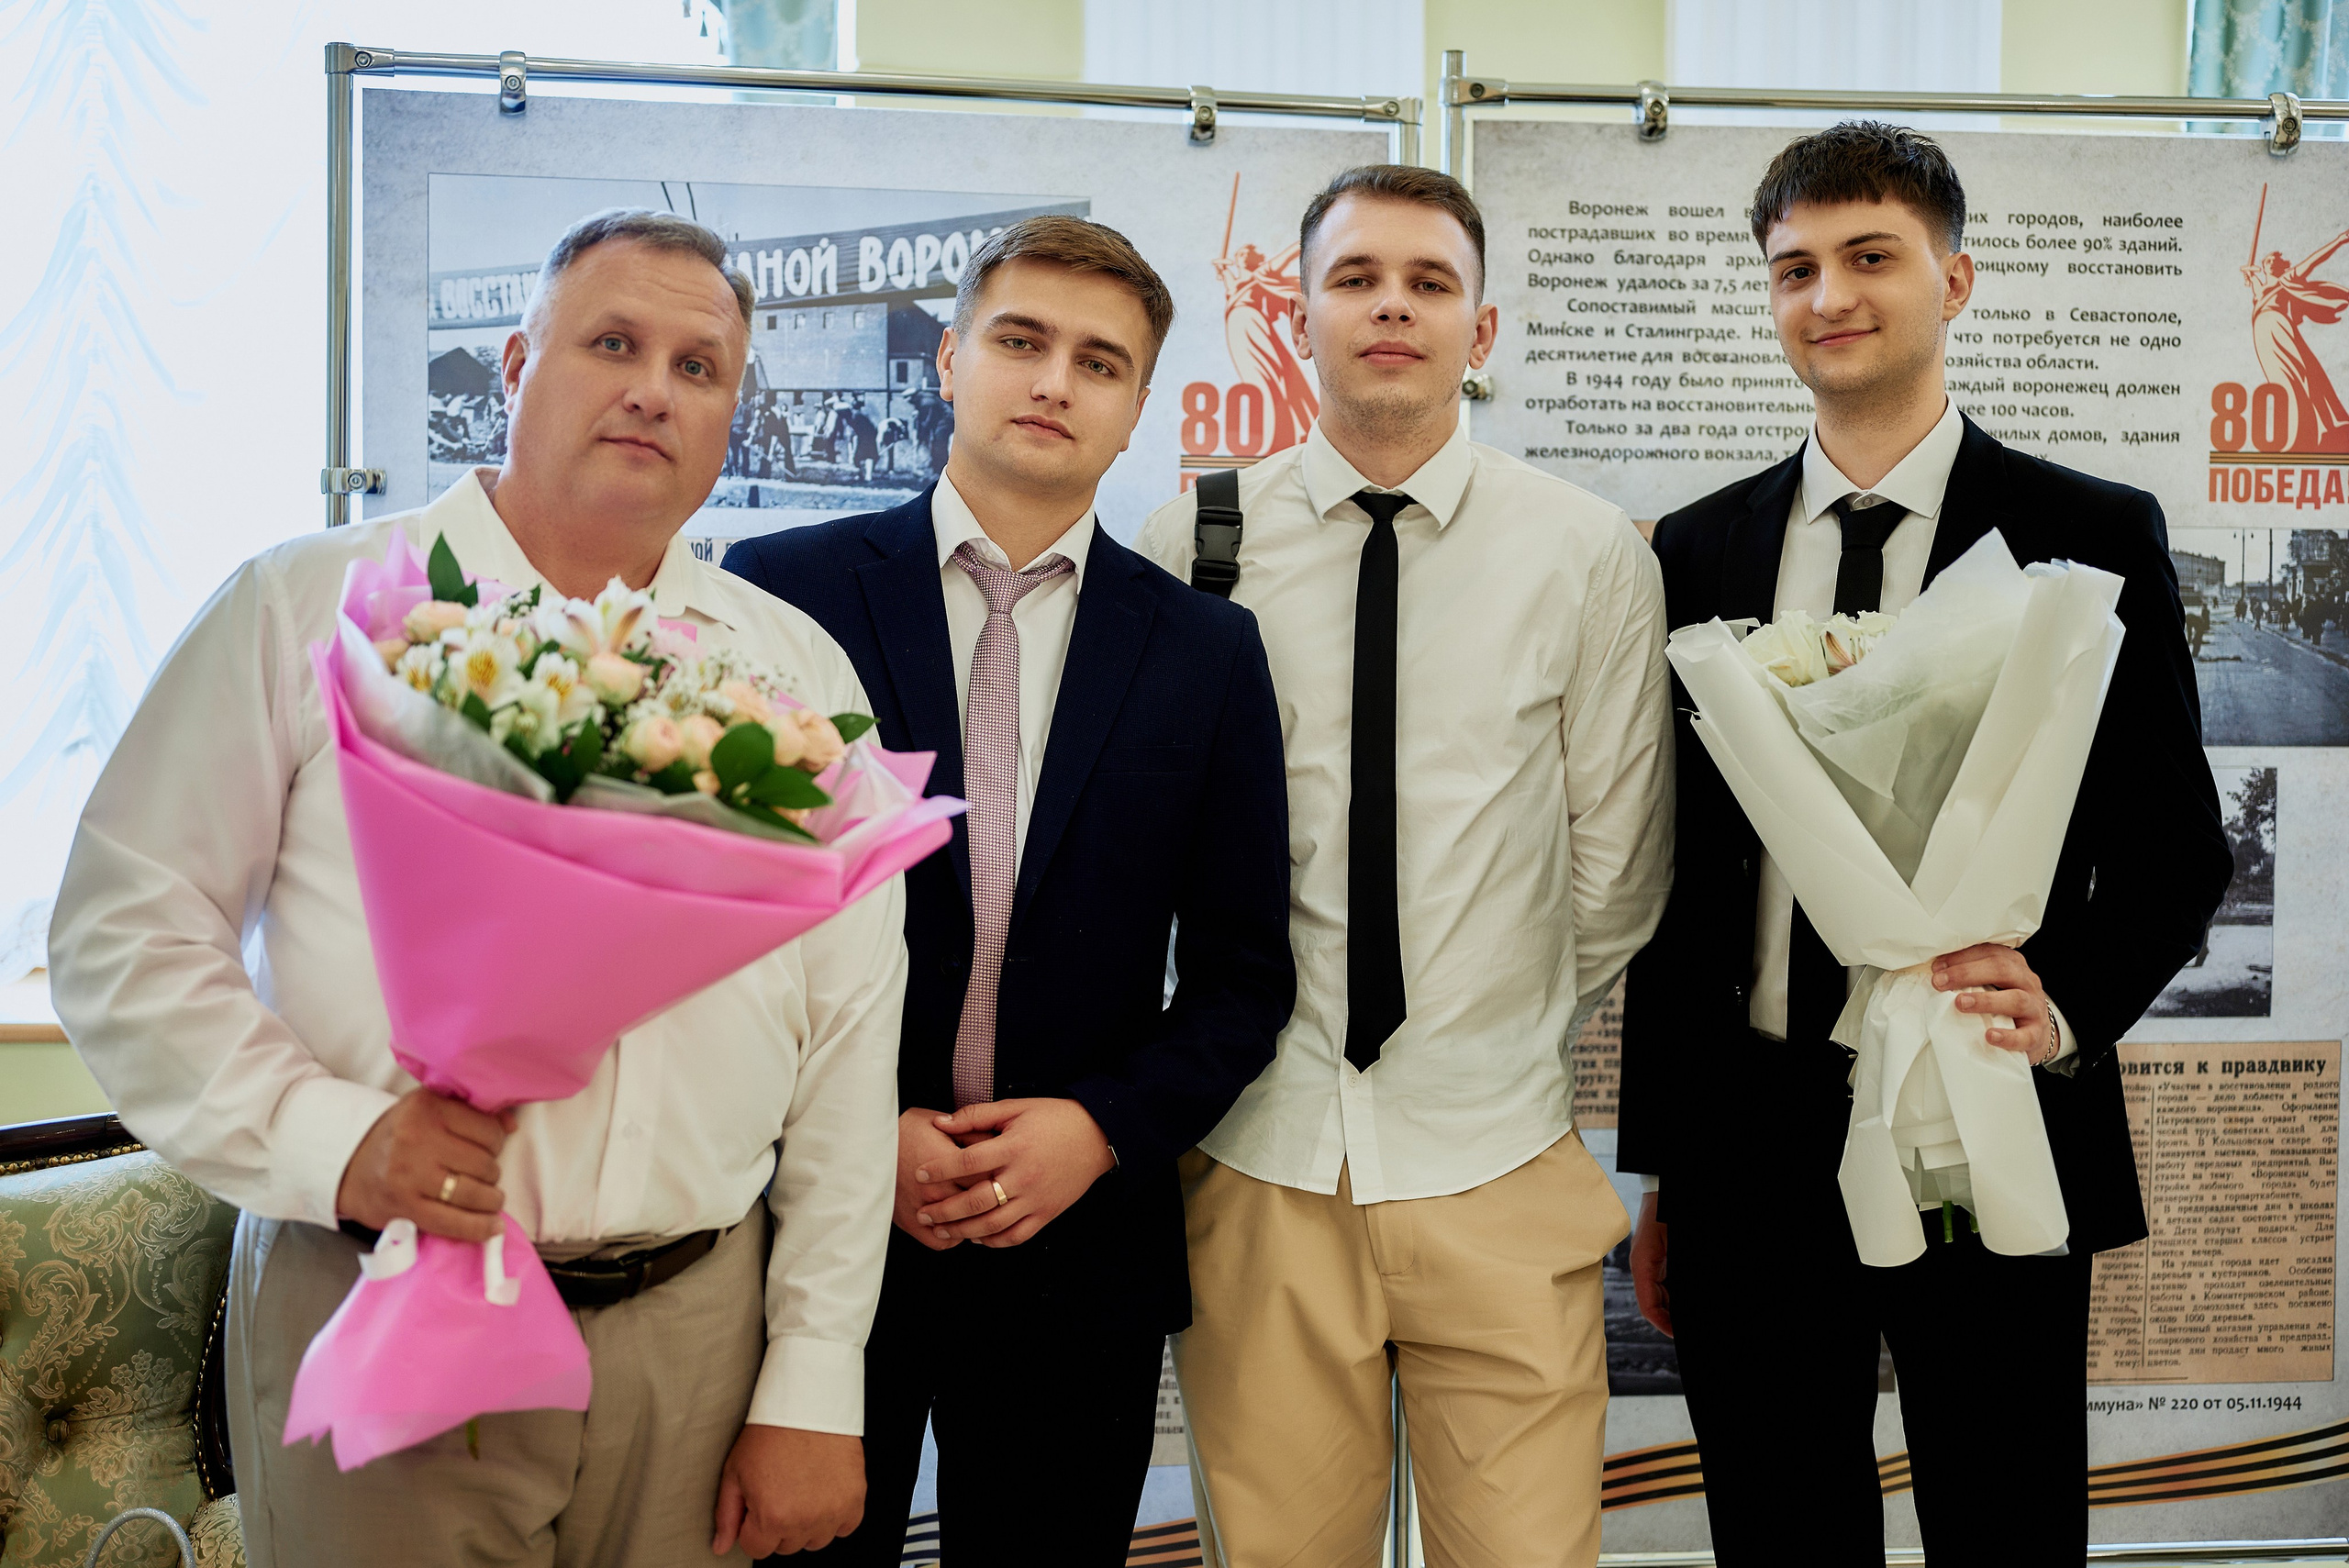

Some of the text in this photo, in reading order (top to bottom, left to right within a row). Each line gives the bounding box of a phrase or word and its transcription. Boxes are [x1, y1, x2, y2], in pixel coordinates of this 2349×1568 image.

[1568, 200, 1649, 219] Воронеж
[1668, 206, 1725, 218] вошел
[1965, 212, 1987, 226] их
[2008, 213, 2084, 229] городов,
[2102, 212, 2184, 228] наиболее
[1528, 228, 1655, 244] пострадавших
[1668, 229, 1689, 242] во
[1696, 230, 1750, 245] время
[2025, 234, 2077, 250] более
[2083, 237, 2113, 253] 90%
[2119, 237, 2183, 253] зданий.
[1528, 249, 1595, 267] Однако
[1613, 249, 1706, 268] благодаря
[2067, 262, 2183, 276] восстановить
[1528, 272, 1608, 293] Воронеж
[1617, 278, 1687, 294] удалось
[1691, 279, 1709, 291] за
[1714, 278, 1737, 294] 7,5
[1566, 297, 1697, 315] Сопоставимый
[1972, 308, 2032, 321] только
[2045, 310, 2055, 321] в
[2069, 307, 2182, 327] Севастополе,
[1604, 327, 1615, 338] и
[1624, 323, 1741, 343] Сталинграде.
[1954, 332, 1983, 344] что
[1993, 329, 2100, 350] потребуется
[2110, 335, 2131, 347] не
[2140, 336, 2182, 350] одно
[1525, 350, 1638, 364] десятилетие
[1641, 351, 1674, 365] для
[2026, 353, 2099, 370] области.
[1566, 371, 2180, 398] В 1944 году было принято аждый воронежец должен
[1181, 381, 1264, 456] 80
[1525, 395, 1628, 414] отработать
[1631, 399, 1652, 411] на
[1991, 404, 2018, 417] 100
[2021, 406, 2075, 417] часов.
[2210, 381, 2289, 452] 80
[1565, 419, 1628, 435] Только
[1635, 424, 1653, 436] за
[1659, 424, 1691, 439] два
[1698, 424, 1738, 439] года
[2047, 429, 2108, 445] домов,
[2121, 431, 2180, 446] здания
[1524, 447, 1700, 463] железнодорожного
[1704, 449, 1778, 463] вокзала,
[2197, 1061, 2209, 1074] к
[2148, 1396, 2166, 1410] №
[2170, 1397, 2199, 1410] 220
[2202, 1398, 2222, 1410] от
[2226, 1396, 2302, 1413] 05.11.1944
